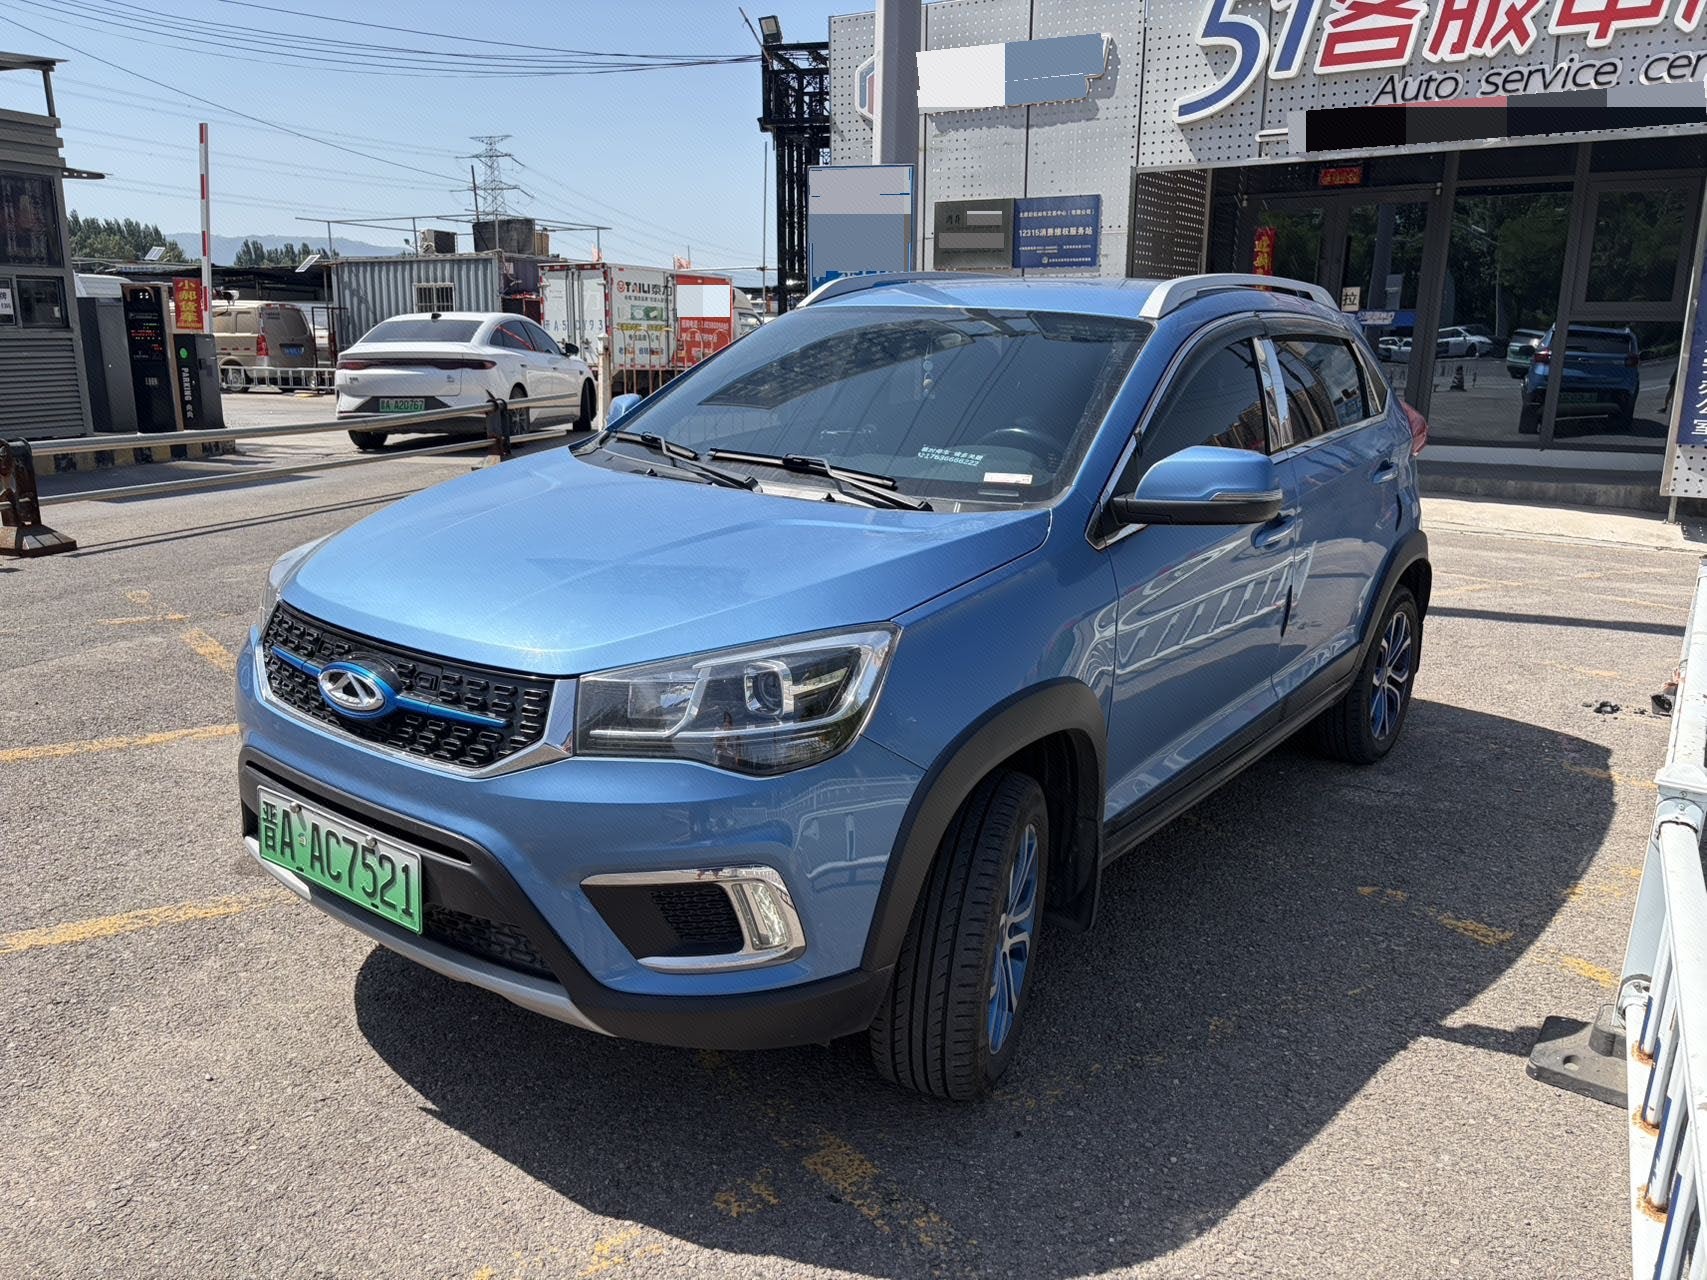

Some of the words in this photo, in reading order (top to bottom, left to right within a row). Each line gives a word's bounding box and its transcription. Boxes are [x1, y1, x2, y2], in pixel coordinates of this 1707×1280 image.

[1371, 74, 1460, 105] Auto
[1480, 56, 1617, 96] service
[1018, 226, 1093, 237] 12315消费维权服务站
[1343, 292, 1358, 306] 拉
[181, 367, 192, 401] PARKING
